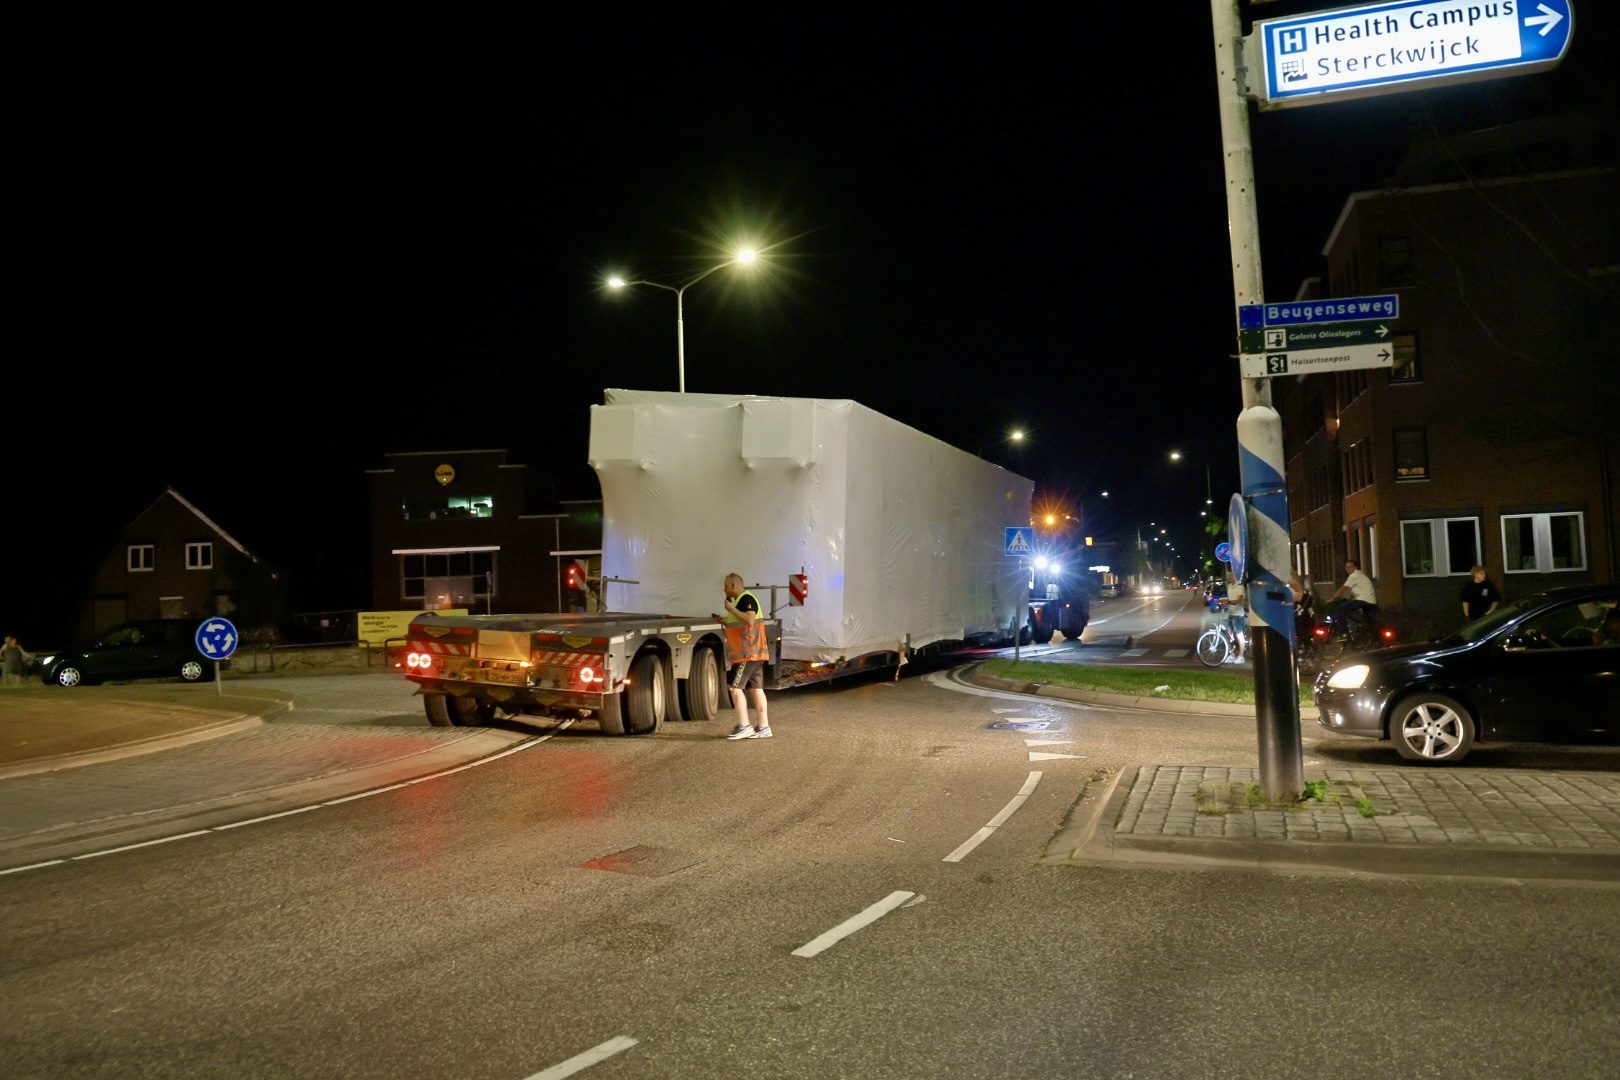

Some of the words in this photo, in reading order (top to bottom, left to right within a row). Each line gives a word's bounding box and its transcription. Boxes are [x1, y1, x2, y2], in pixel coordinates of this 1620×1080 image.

[1314, 15, 1399, 45] Health
[1409, 0, 1515, 30] Campus
[1317, 36, 1480, 76] Sterckwijck
[1268, 301, 1393, 320] Beugenseweg
[1291, 355, 1351, 366] Huisartsenpost
